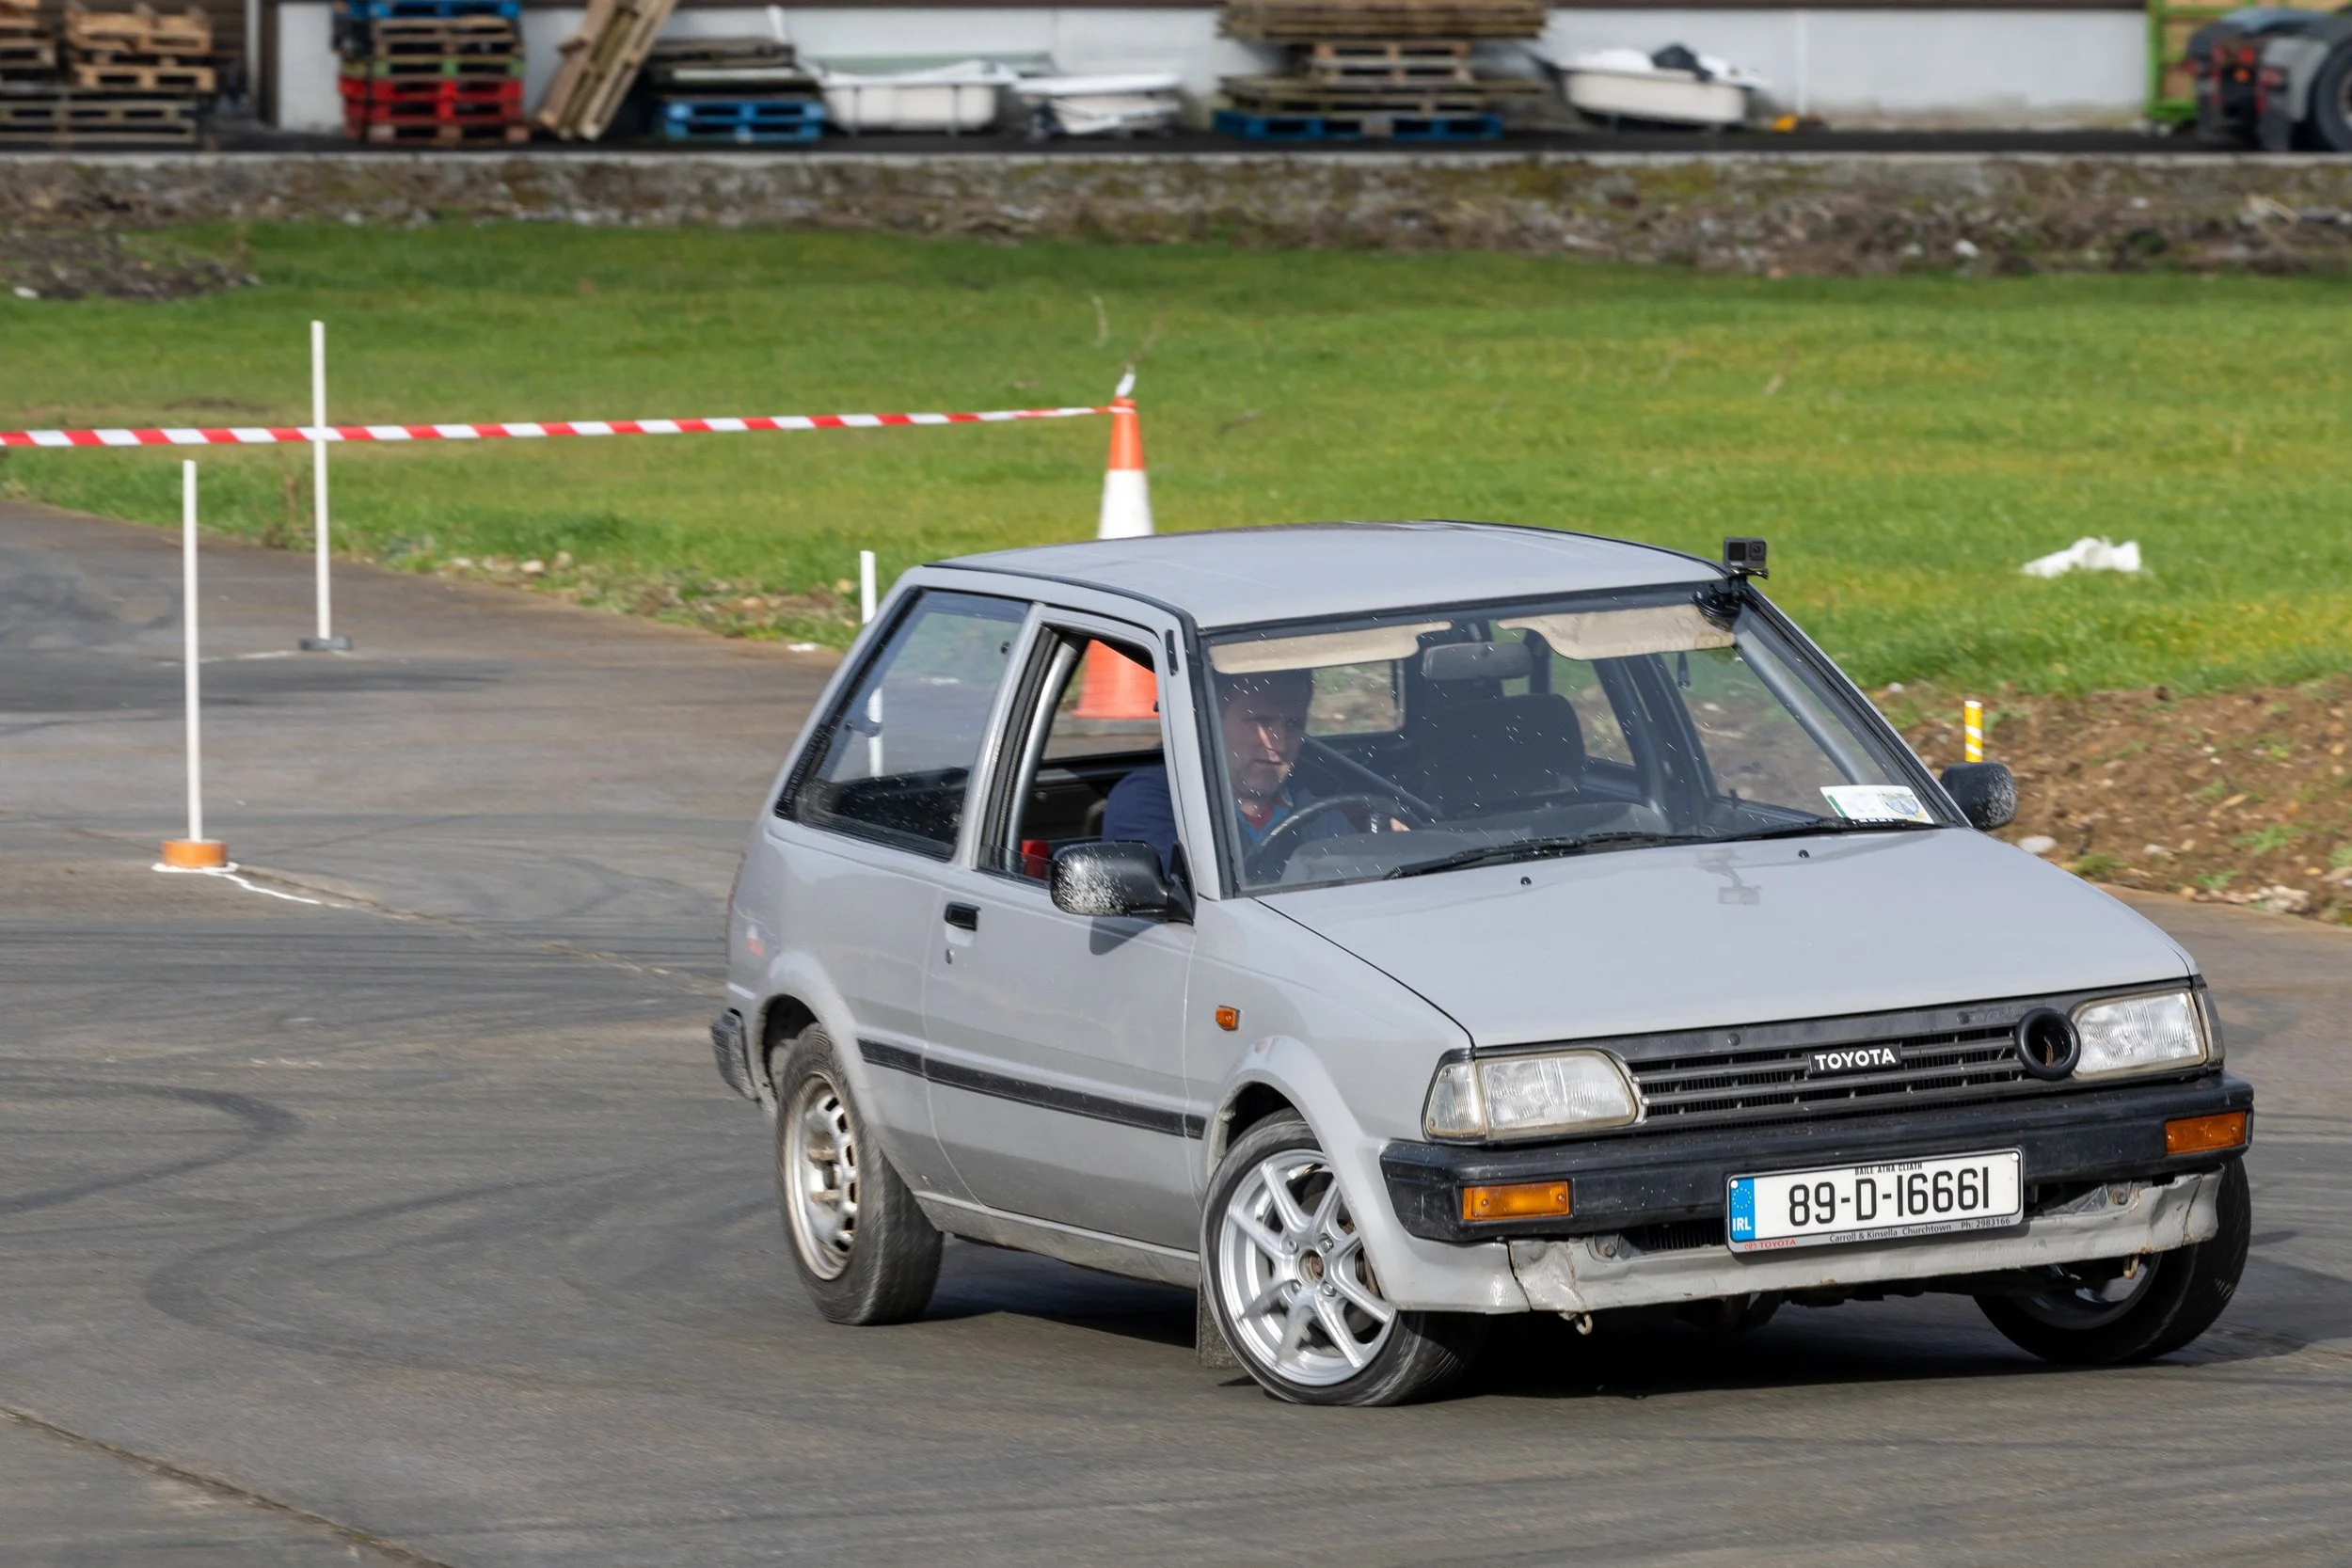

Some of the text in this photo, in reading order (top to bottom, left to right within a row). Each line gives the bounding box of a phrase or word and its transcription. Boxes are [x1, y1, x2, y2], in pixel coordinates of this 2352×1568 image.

[1814, 1047, 1896, 1071] TOYOTA
[1788, 1166, 1990, 1227] 89-D-16661
[1732, 1216, 1752, 1232] IRL
[1829, 1217, 2010, 1243] Carroll & Kinsella Churchtown Ph: 2983166
[1759, 1238, 1796, 1249] TOYOTA
